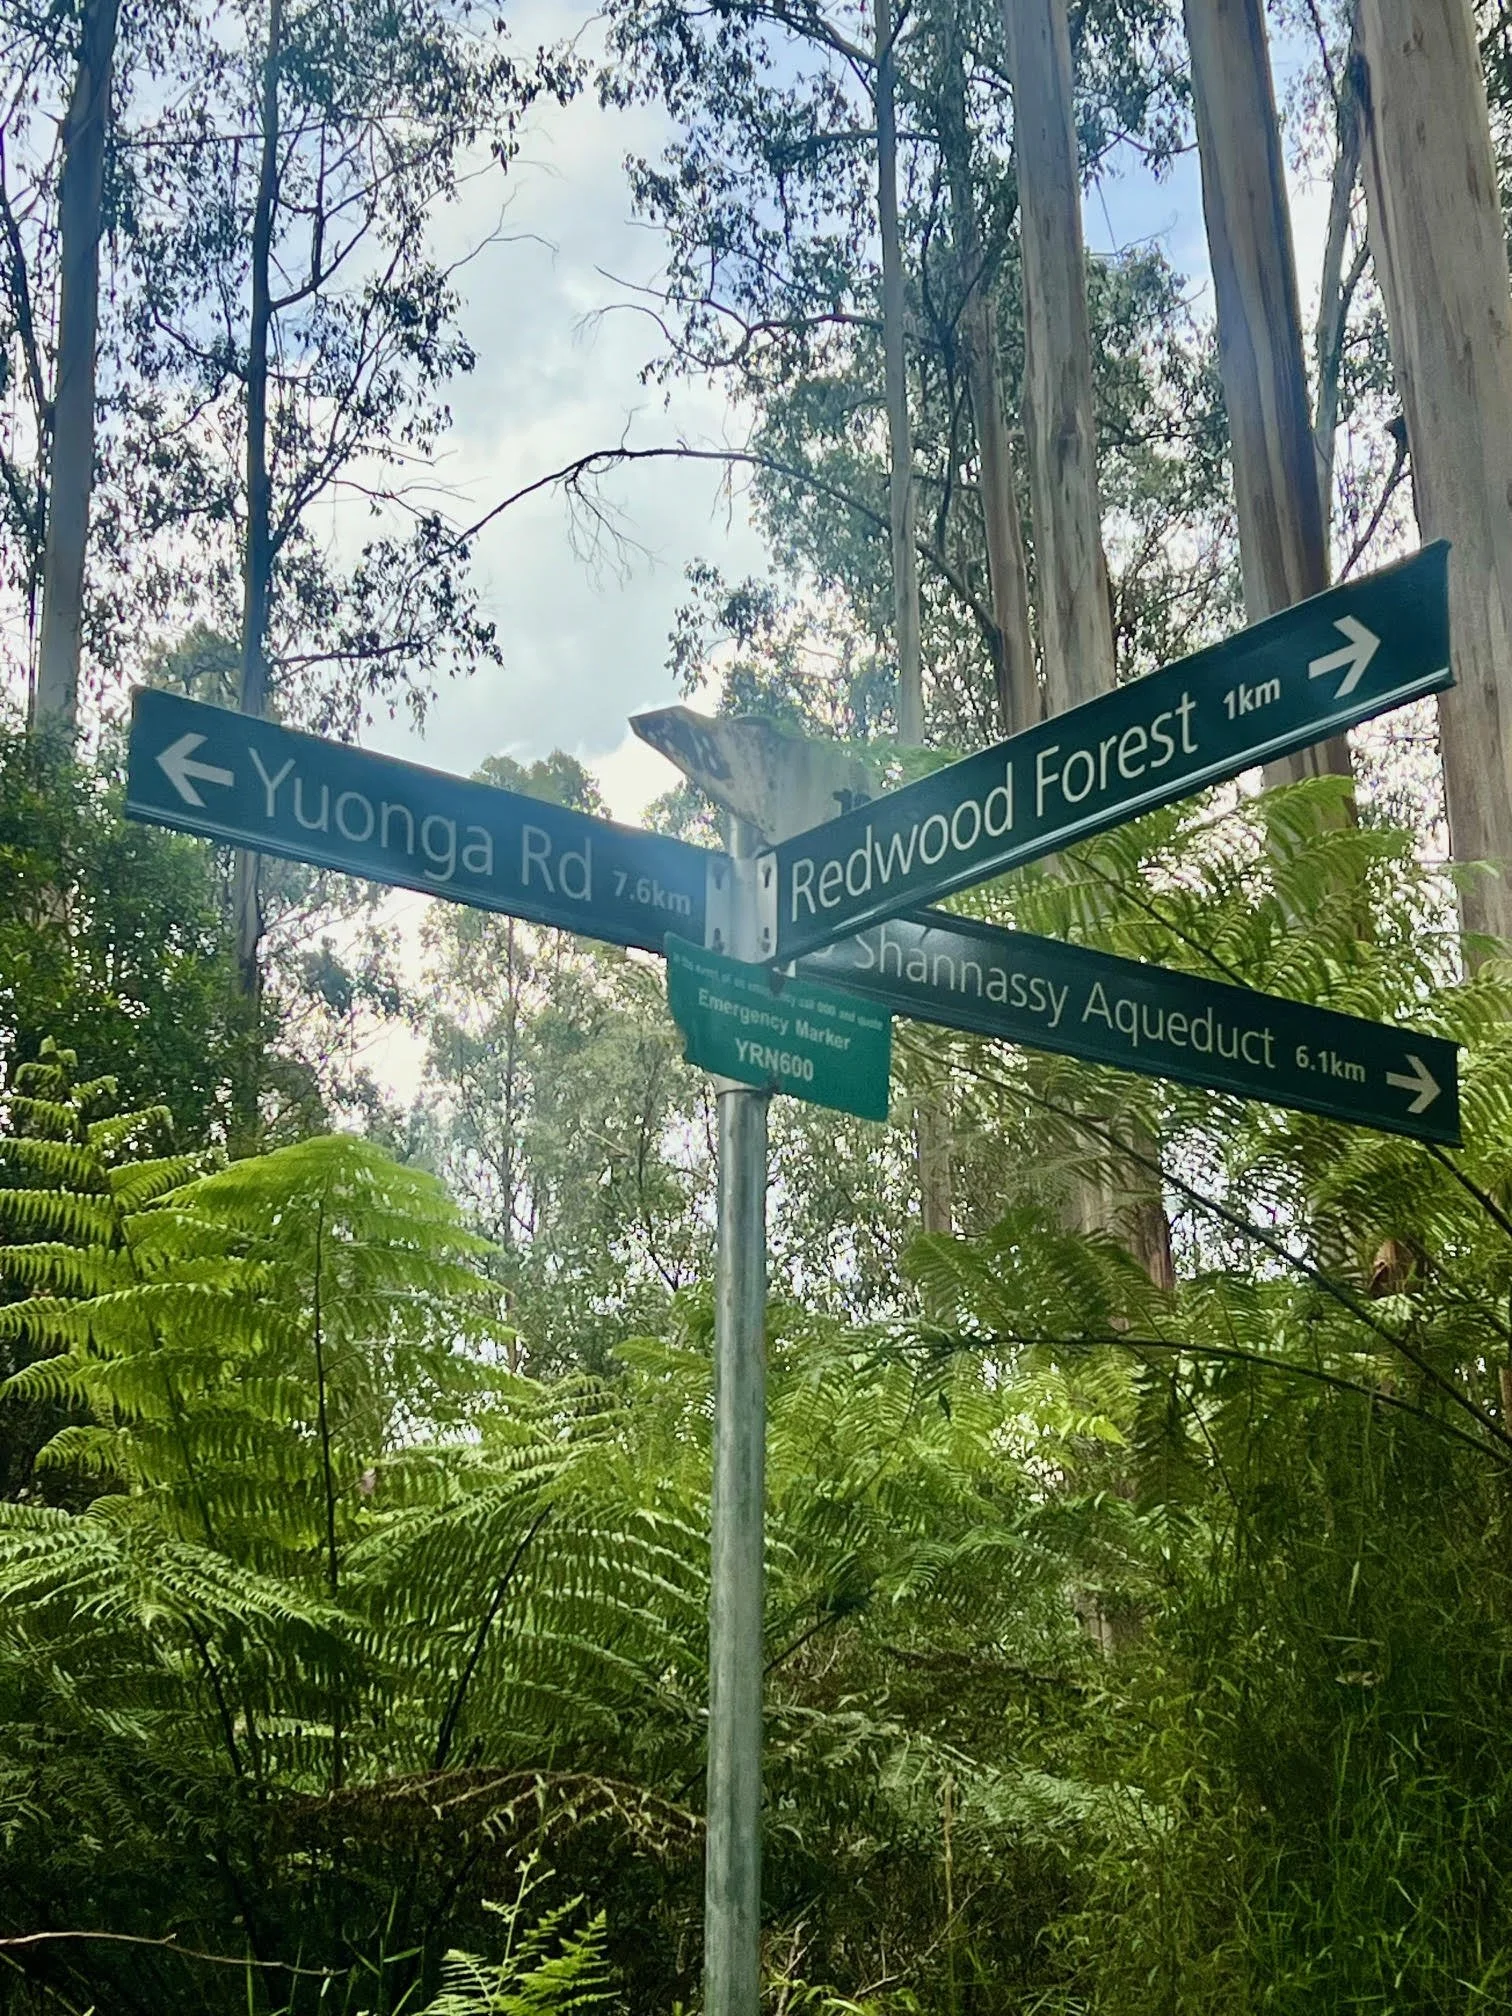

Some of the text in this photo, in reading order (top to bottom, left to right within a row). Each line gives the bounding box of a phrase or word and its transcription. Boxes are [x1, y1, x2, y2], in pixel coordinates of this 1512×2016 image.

[248, 747, 692, 916] Yuonga Rd 7.6km
[791, 675, 1281, 921] Redwood Forest 1km
[698, 988, 790, 1037] Emergency
[795, 1019, 851, 1050] Marker
[735, 1037, 815, 1082] YRN600
[811, 925, 1367, 1083] Shannassy Aqueduct 6.1km
